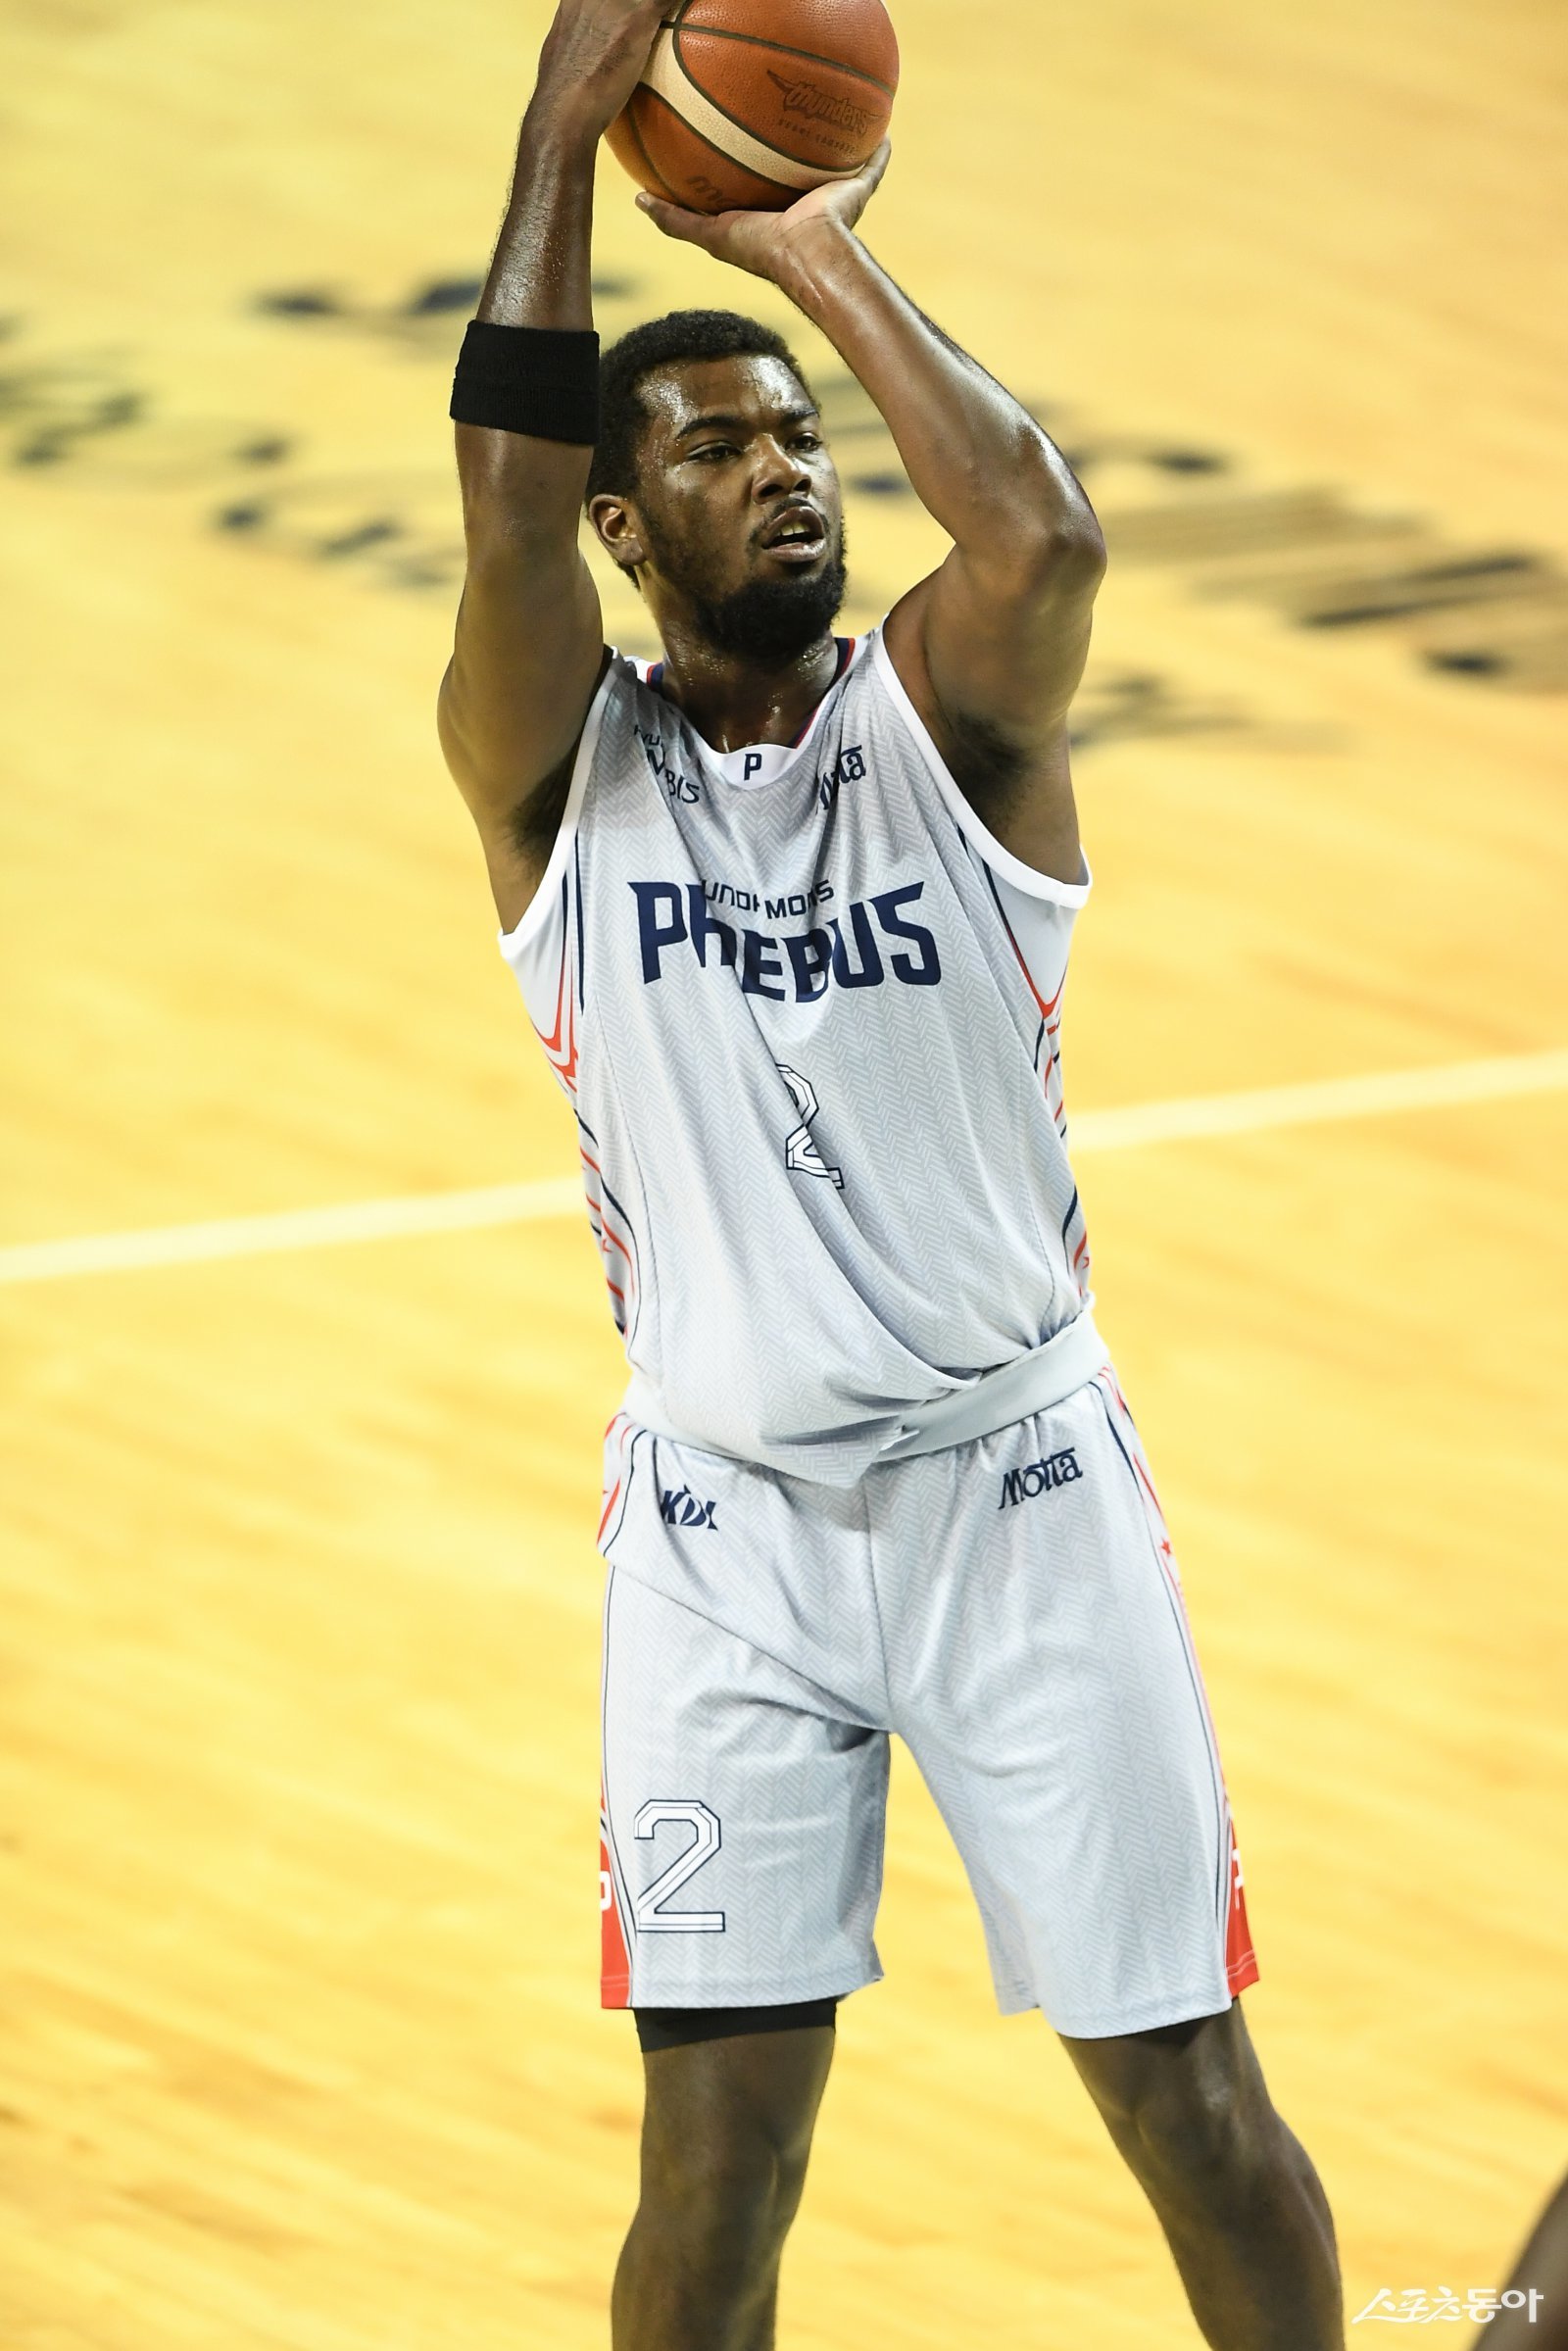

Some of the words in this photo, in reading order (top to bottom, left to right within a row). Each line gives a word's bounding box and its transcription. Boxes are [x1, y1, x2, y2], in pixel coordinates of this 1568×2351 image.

[744, 753, 762, 781] P
[775, 1063, 845, 1189] 2
[998, 1446, 1083, 1509] Motta
[634, 1799, 725, 1932] 2
